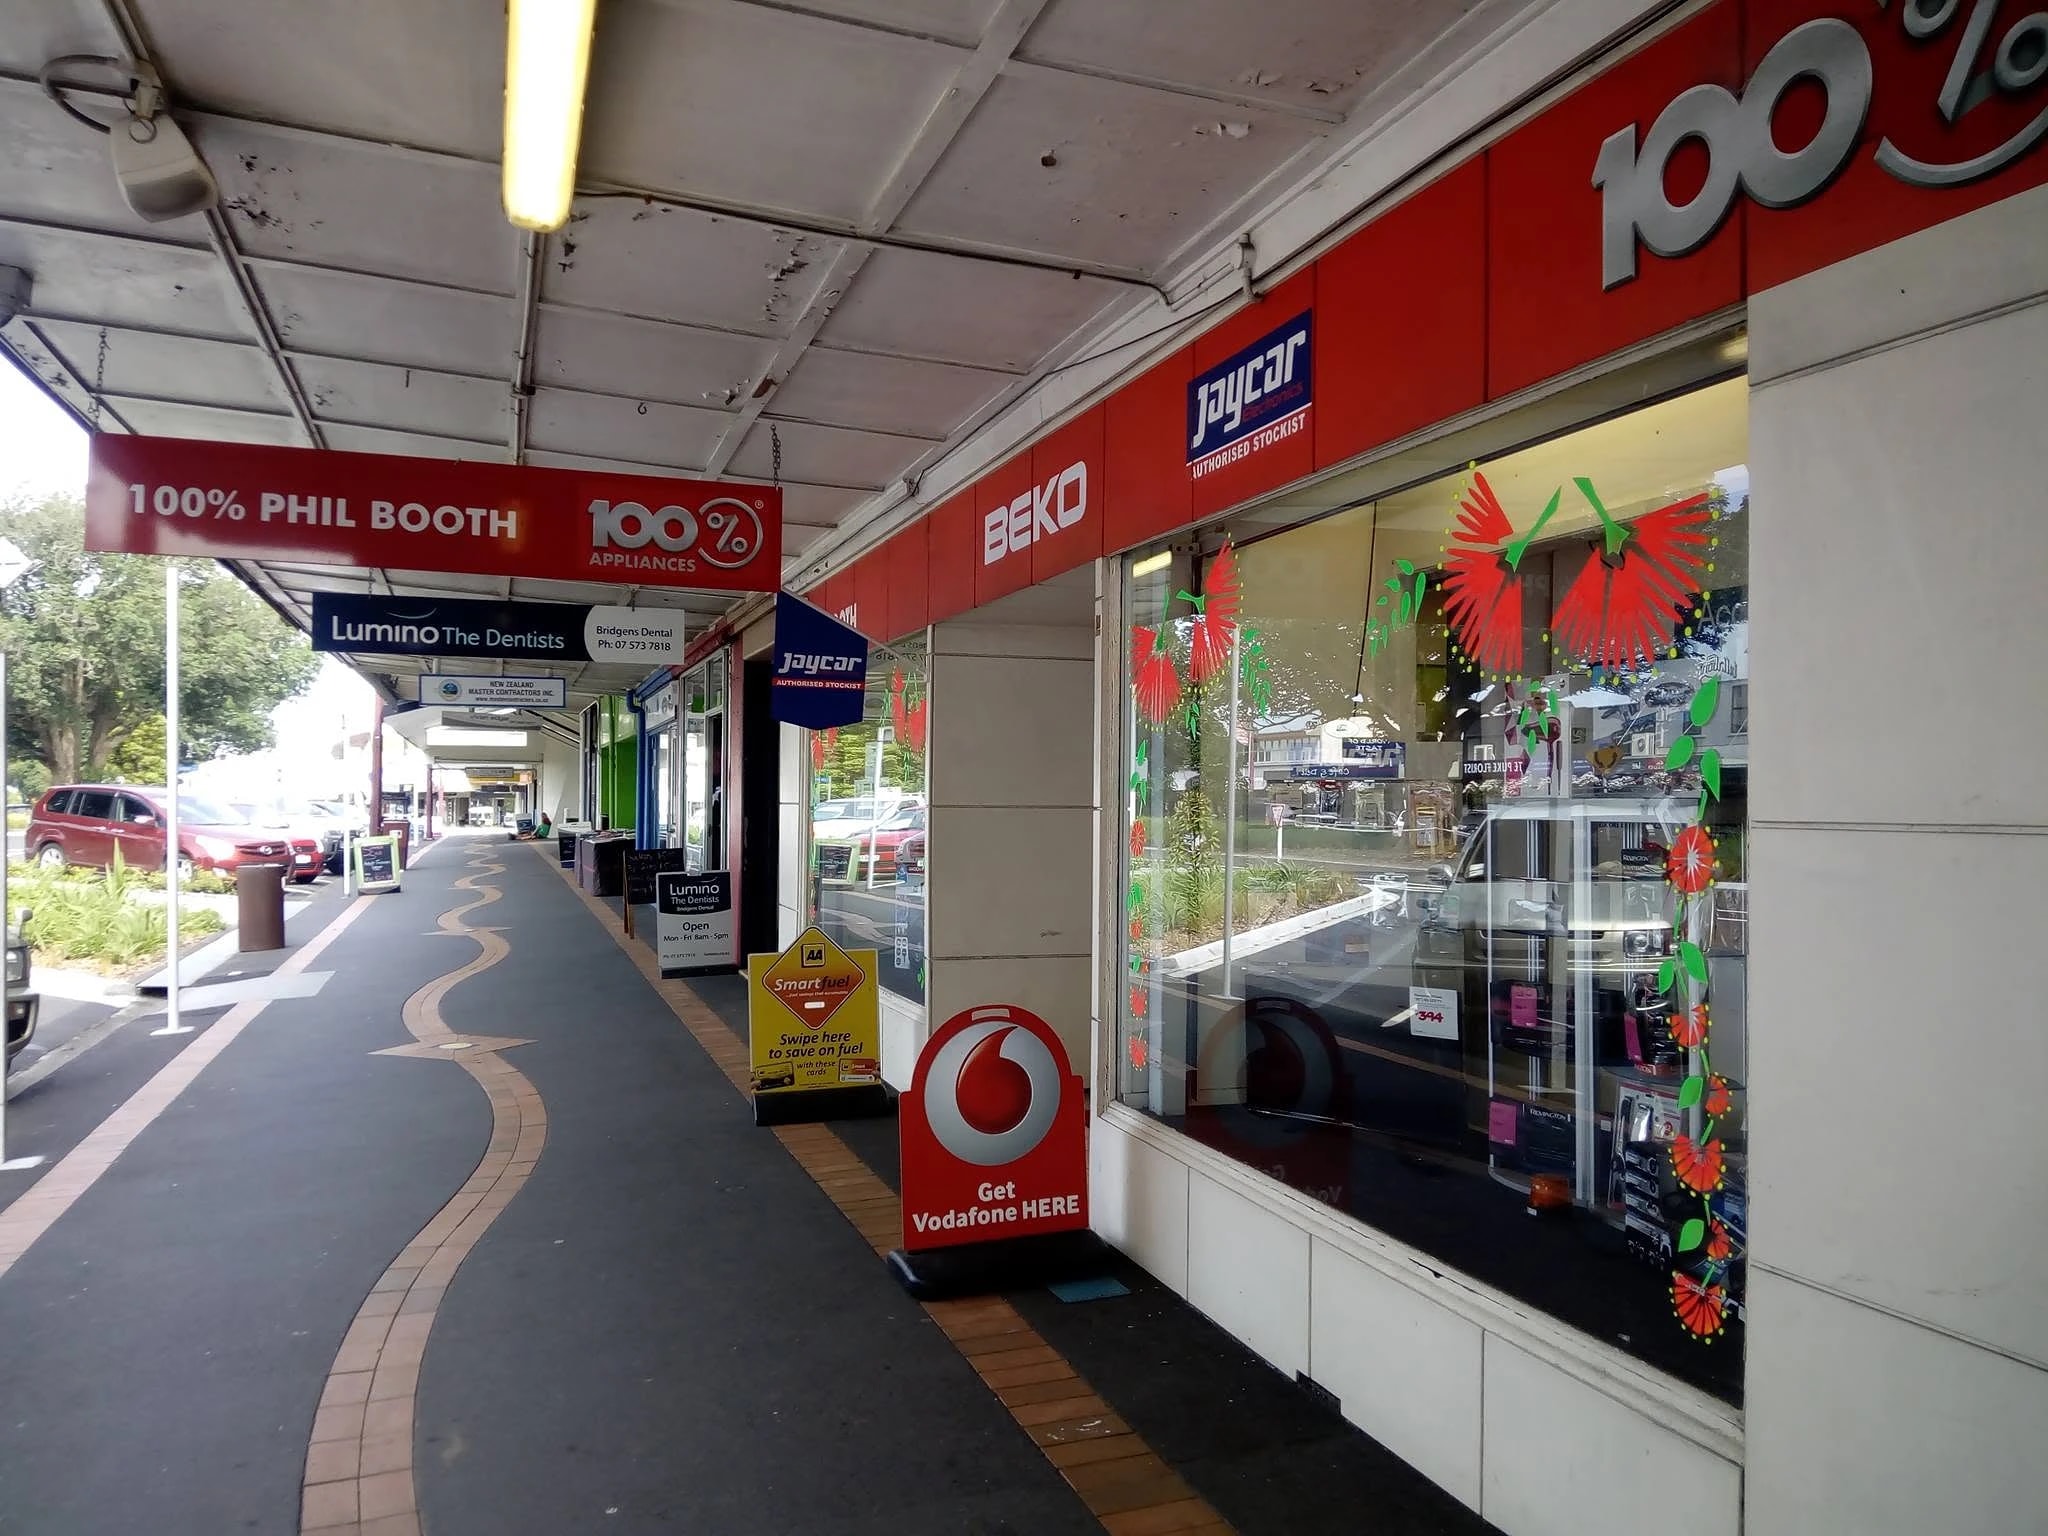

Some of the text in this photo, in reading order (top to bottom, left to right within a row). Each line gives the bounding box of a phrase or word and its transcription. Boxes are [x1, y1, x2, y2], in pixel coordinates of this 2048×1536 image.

[1253, 413, 1306, 451] STOCKIST
[130, 484, 516, 539] 100% PHIL BOOTH
[984, 460, 1087, 566] BEKO
[589, 552, 696, 573] APPLIANCES
[332, 615, 565, 650] Lumino The Dentists
[596, 626, 673, 638] Bridgens Dental
[598, 639, 671, 651] Ph: 07 573 7818
[776, 680, 862, 689] AUTHORISED STOCKIST
[669, 883, 720, 896] Lumino
[671, 895, 720, 905] The Dentists
[682, 922, 709, 935] Open
[694, 933, 709, 941] 8am
[714, 932, 729, 941] 5pm
[806, 949, 822, 961] AA
[779, 1030, 851, 1048] Swipe here
[769, 1042, 863, 1059] to save on fuel
[796, 1060, 836, 1069] with these
[806, 1068, 827, 1077] cards
[978, 1180, 1016, 1202] Get
[912, 1194, 1080, 1233] Vodafone HERE
